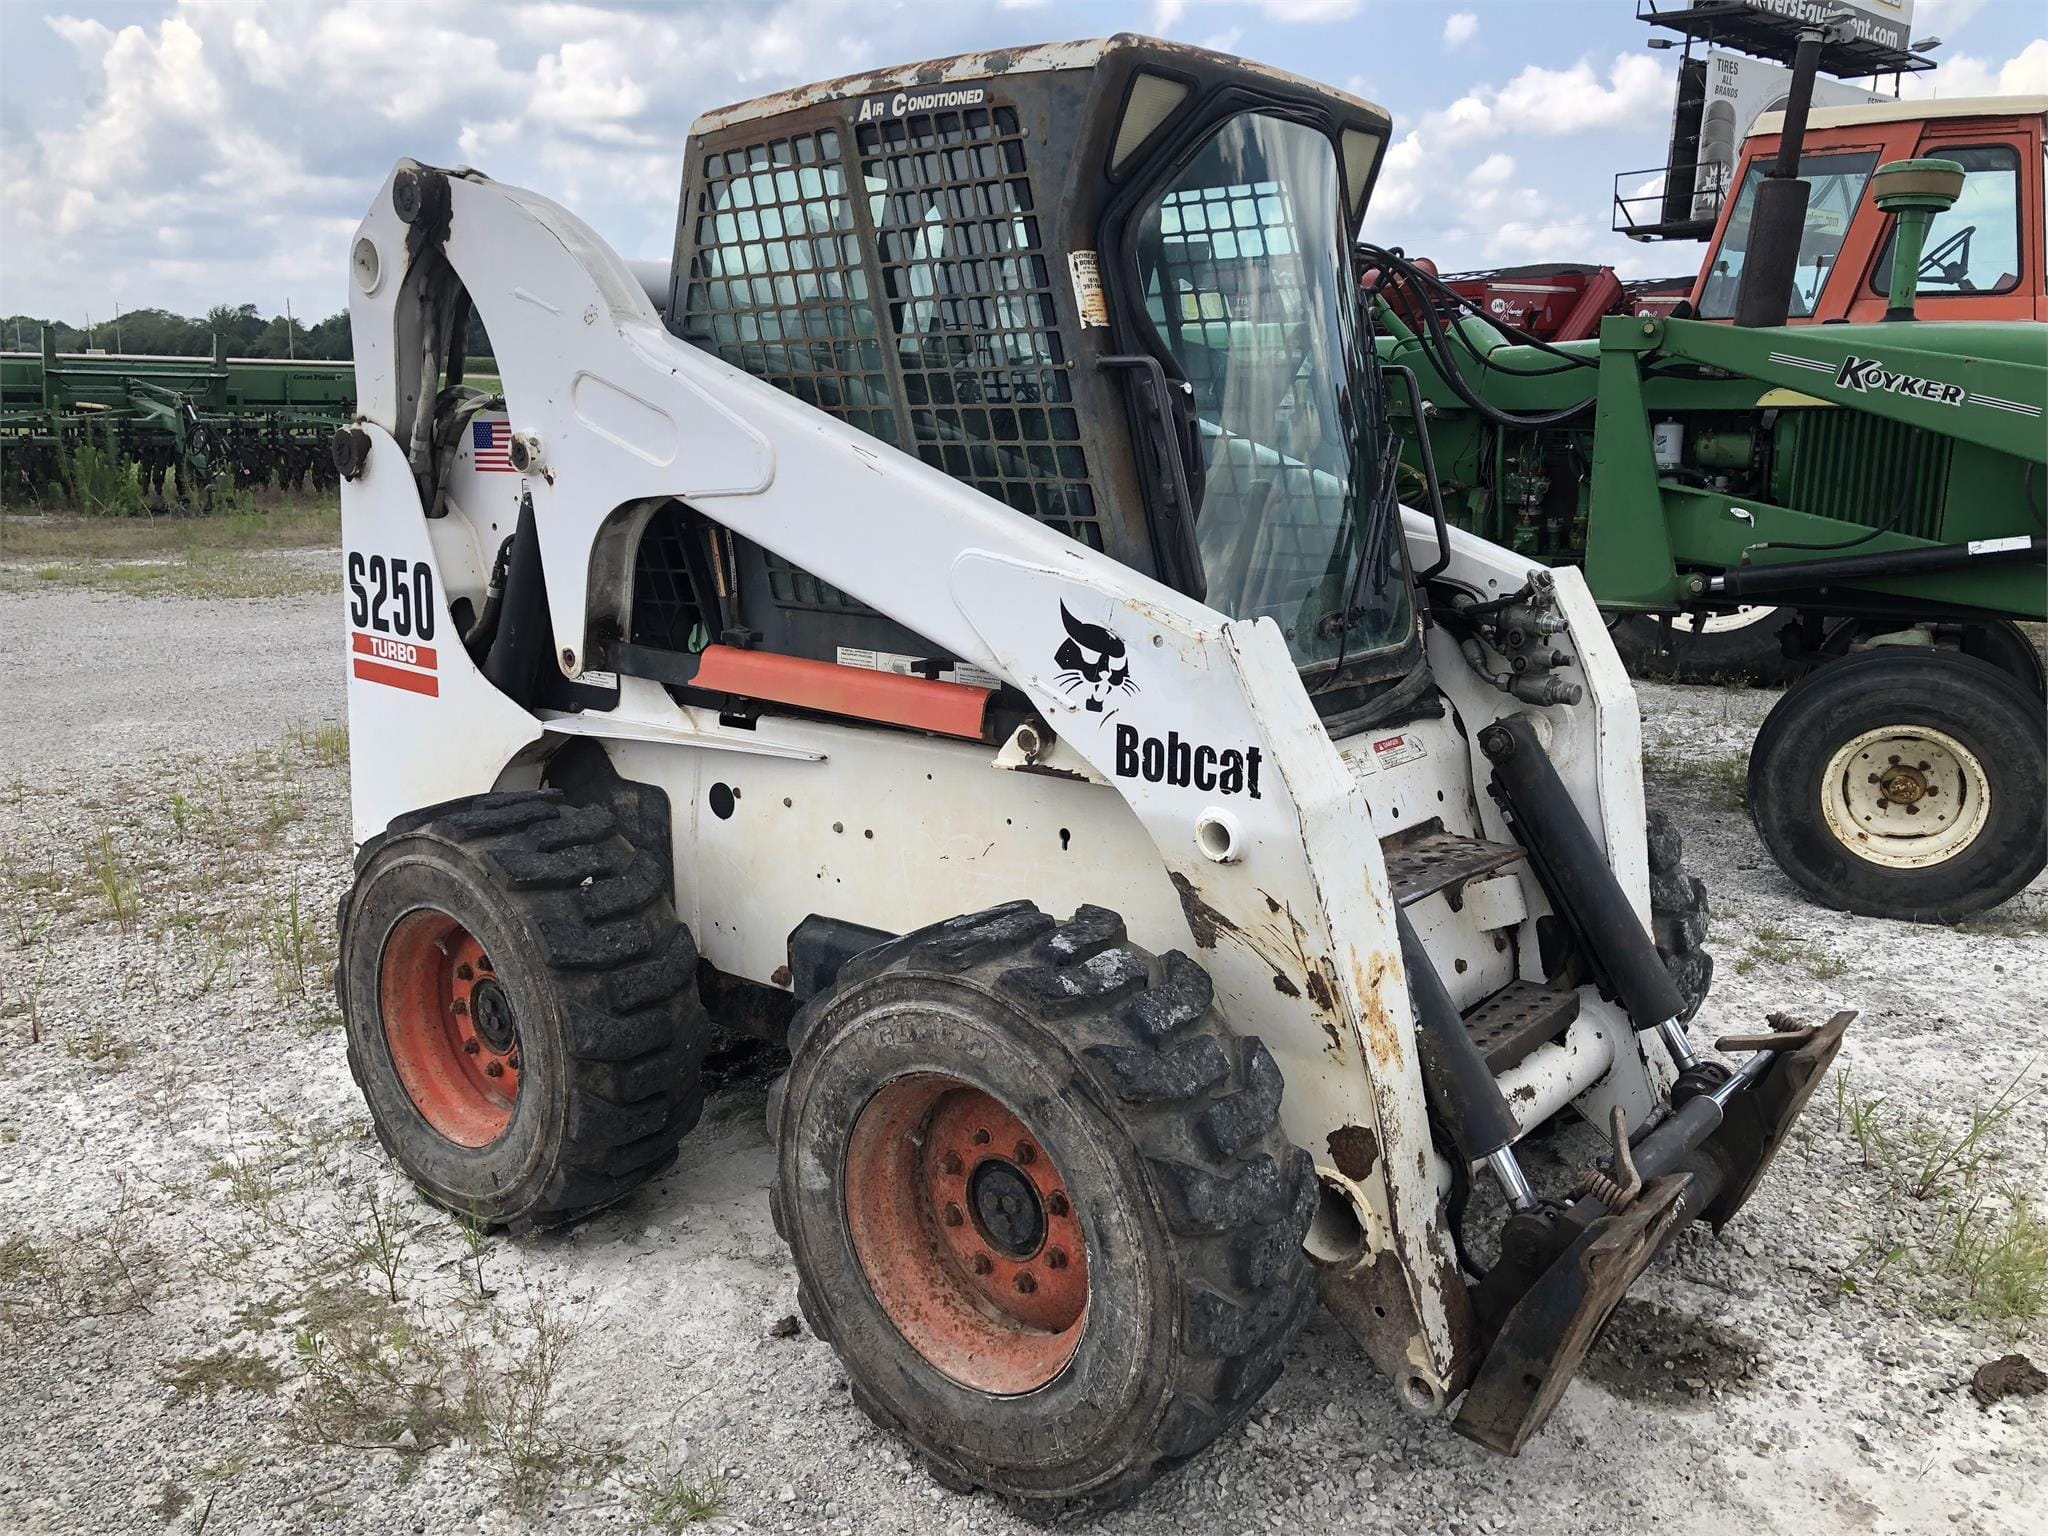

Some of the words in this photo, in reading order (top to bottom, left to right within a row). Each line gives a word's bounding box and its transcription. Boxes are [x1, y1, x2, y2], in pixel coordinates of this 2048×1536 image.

[1716, 58, 1739, 76] TIRES
[1714, 84, 1739, 99] BRANDS
[1721, 75, 1733, 86] ALL
[348, 551, 435, 641] S250
[370, 637, 417, 664] TURBO
[1116, 723, 1262, 799] Bobcat
